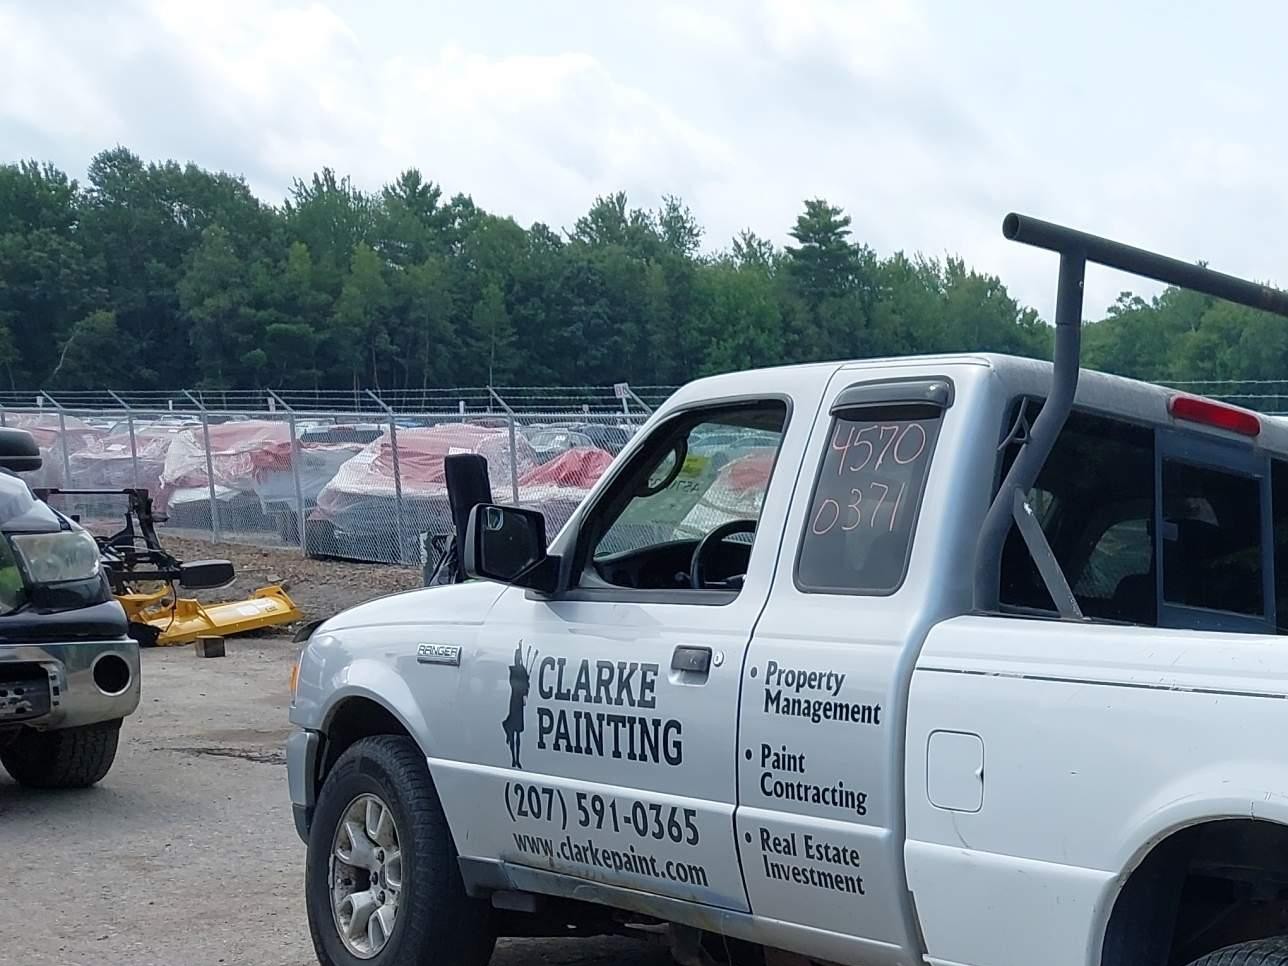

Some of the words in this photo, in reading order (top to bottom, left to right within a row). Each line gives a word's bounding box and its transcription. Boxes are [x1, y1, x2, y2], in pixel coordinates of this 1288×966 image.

[831, 423, 926, 476] 4570
[812, 482, 906, 535] 0371
[418, 644, 459, 657] RANGER
[538, 656, 660, 709] CLARKE
[765, 660, 846, 697] Property
[763, 688, 882, 725] Management
[536, 706, 683, 766] PAINTING
[761, 743, 806, 773] Paint
[504, 781, 568, 831] (207)
[576, 791, 700, 846] 591-0365
[760, 771, 868, 816] Contracting
[512, 832, 709, 887] www.clarkepaint.com
[759, 827, 798, 857] Real
[803, 834, 861, 868] Estate
[762, 854, 866, 896] Investment
